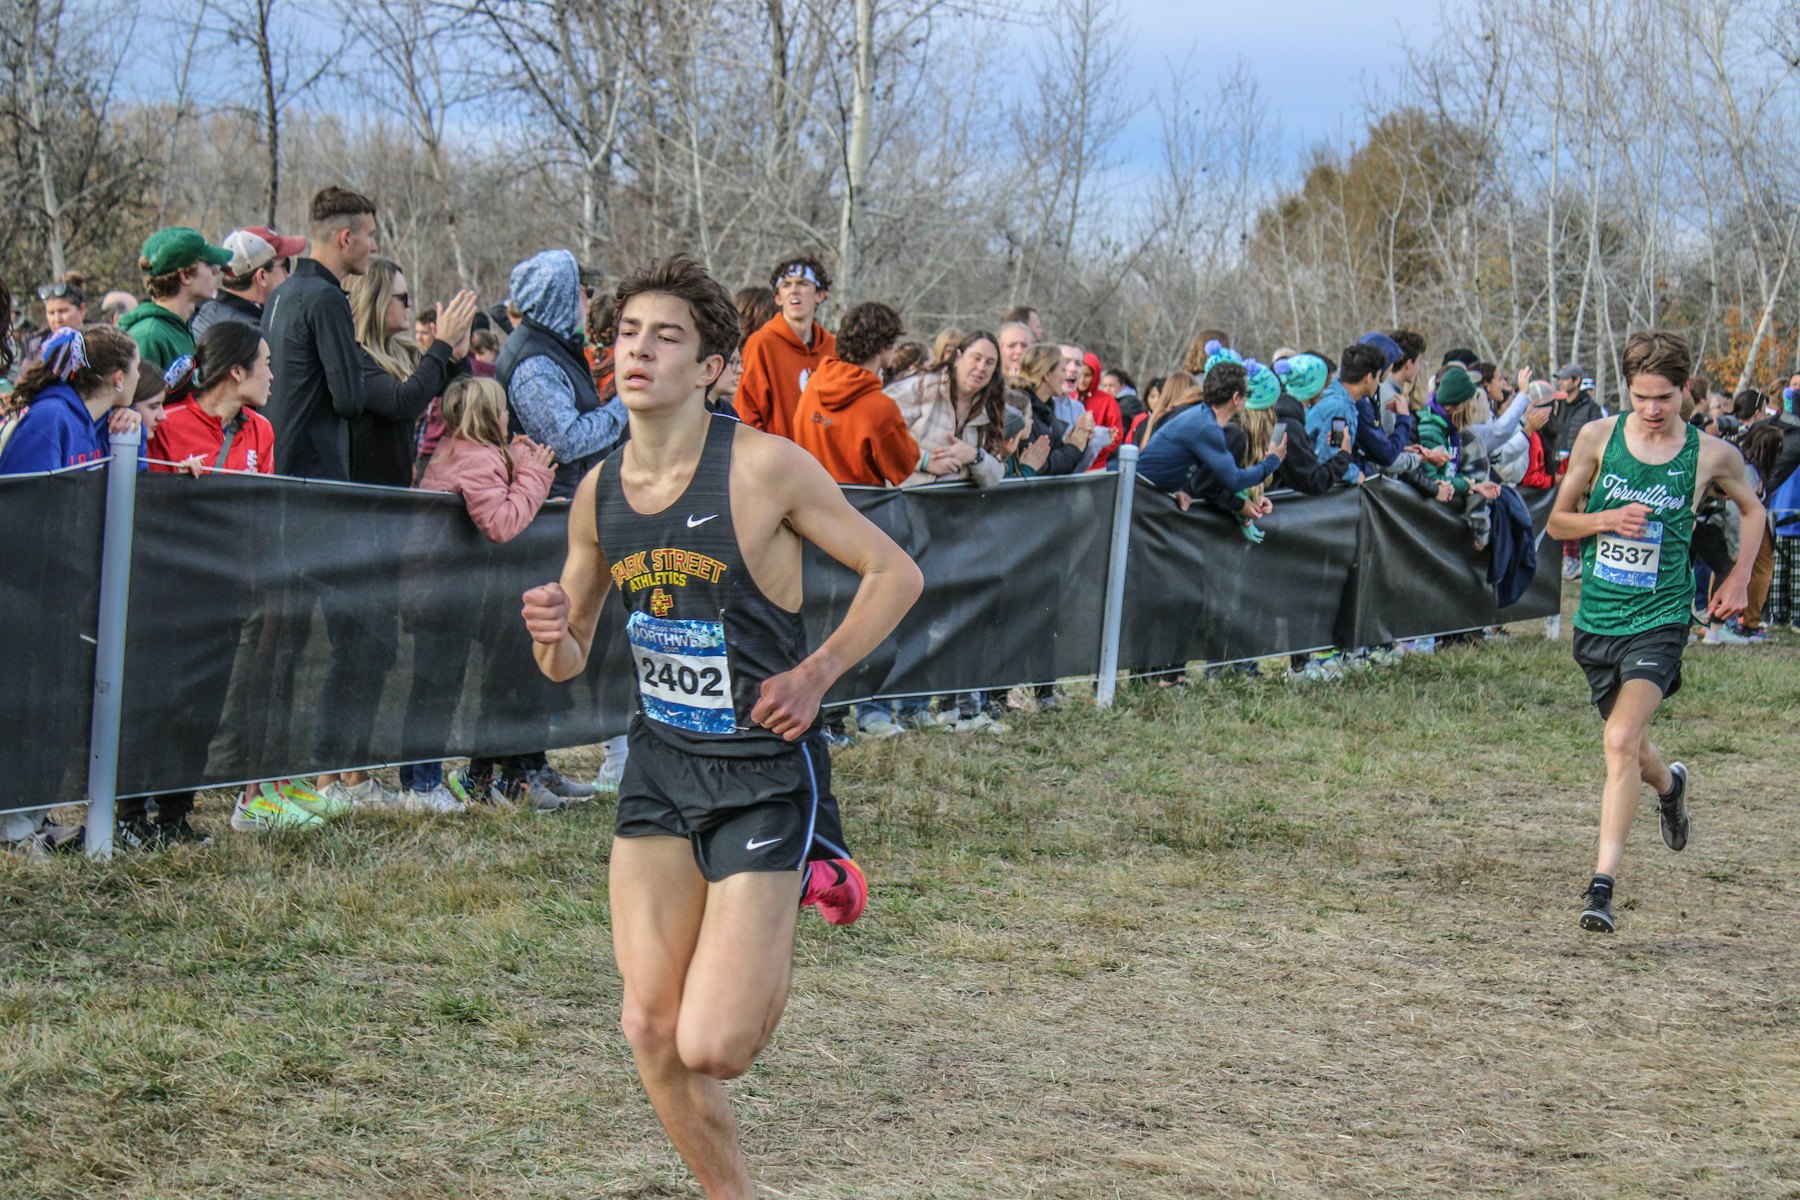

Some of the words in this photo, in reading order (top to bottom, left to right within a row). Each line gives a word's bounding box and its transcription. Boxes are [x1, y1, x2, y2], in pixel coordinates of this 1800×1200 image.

[1603, 473, 1686, 515] Terwilliger
[651, 548, 727, 584] STREET
[1600, 540, 1654, 566] 2537
[629, 571, 687, 593] ATHLETICS
[642, 657, 724, 697] 2402
